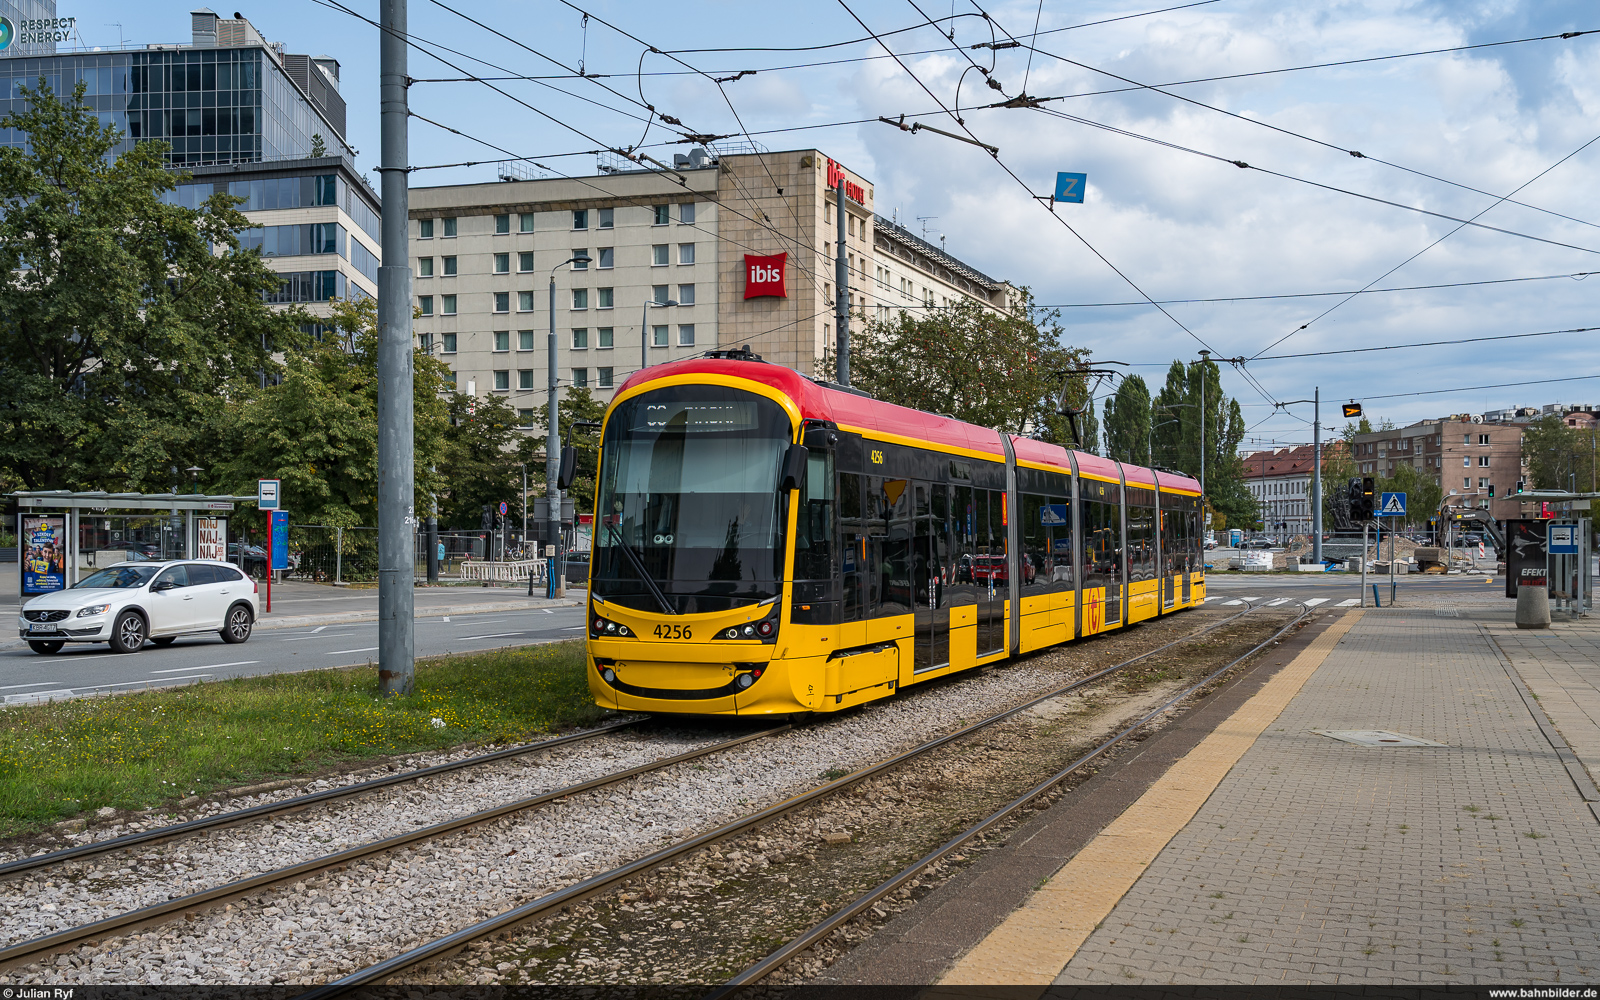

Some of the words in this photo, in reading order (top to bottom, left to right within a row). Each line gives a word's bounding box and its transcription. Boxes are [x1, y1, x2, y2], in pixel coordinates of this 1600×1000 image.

[20, 17, 75, 31] RESPECT
[20, 30, 70, 44] ENERGY
[827, 158, 846, 190] ibis
[846, 180, 865, 205] HOTEL
[1063, 178, 1078, 197] Z
[751, 265, 781, 284] ibis
[870, 449, 884, 465] 4256
[199, 530, 218, 544] NAJ
[199, 545, 218, 559] NAJ
[1521, 568, 1547, 576] EFEKT
[653, 624, 692, 640] 4256
